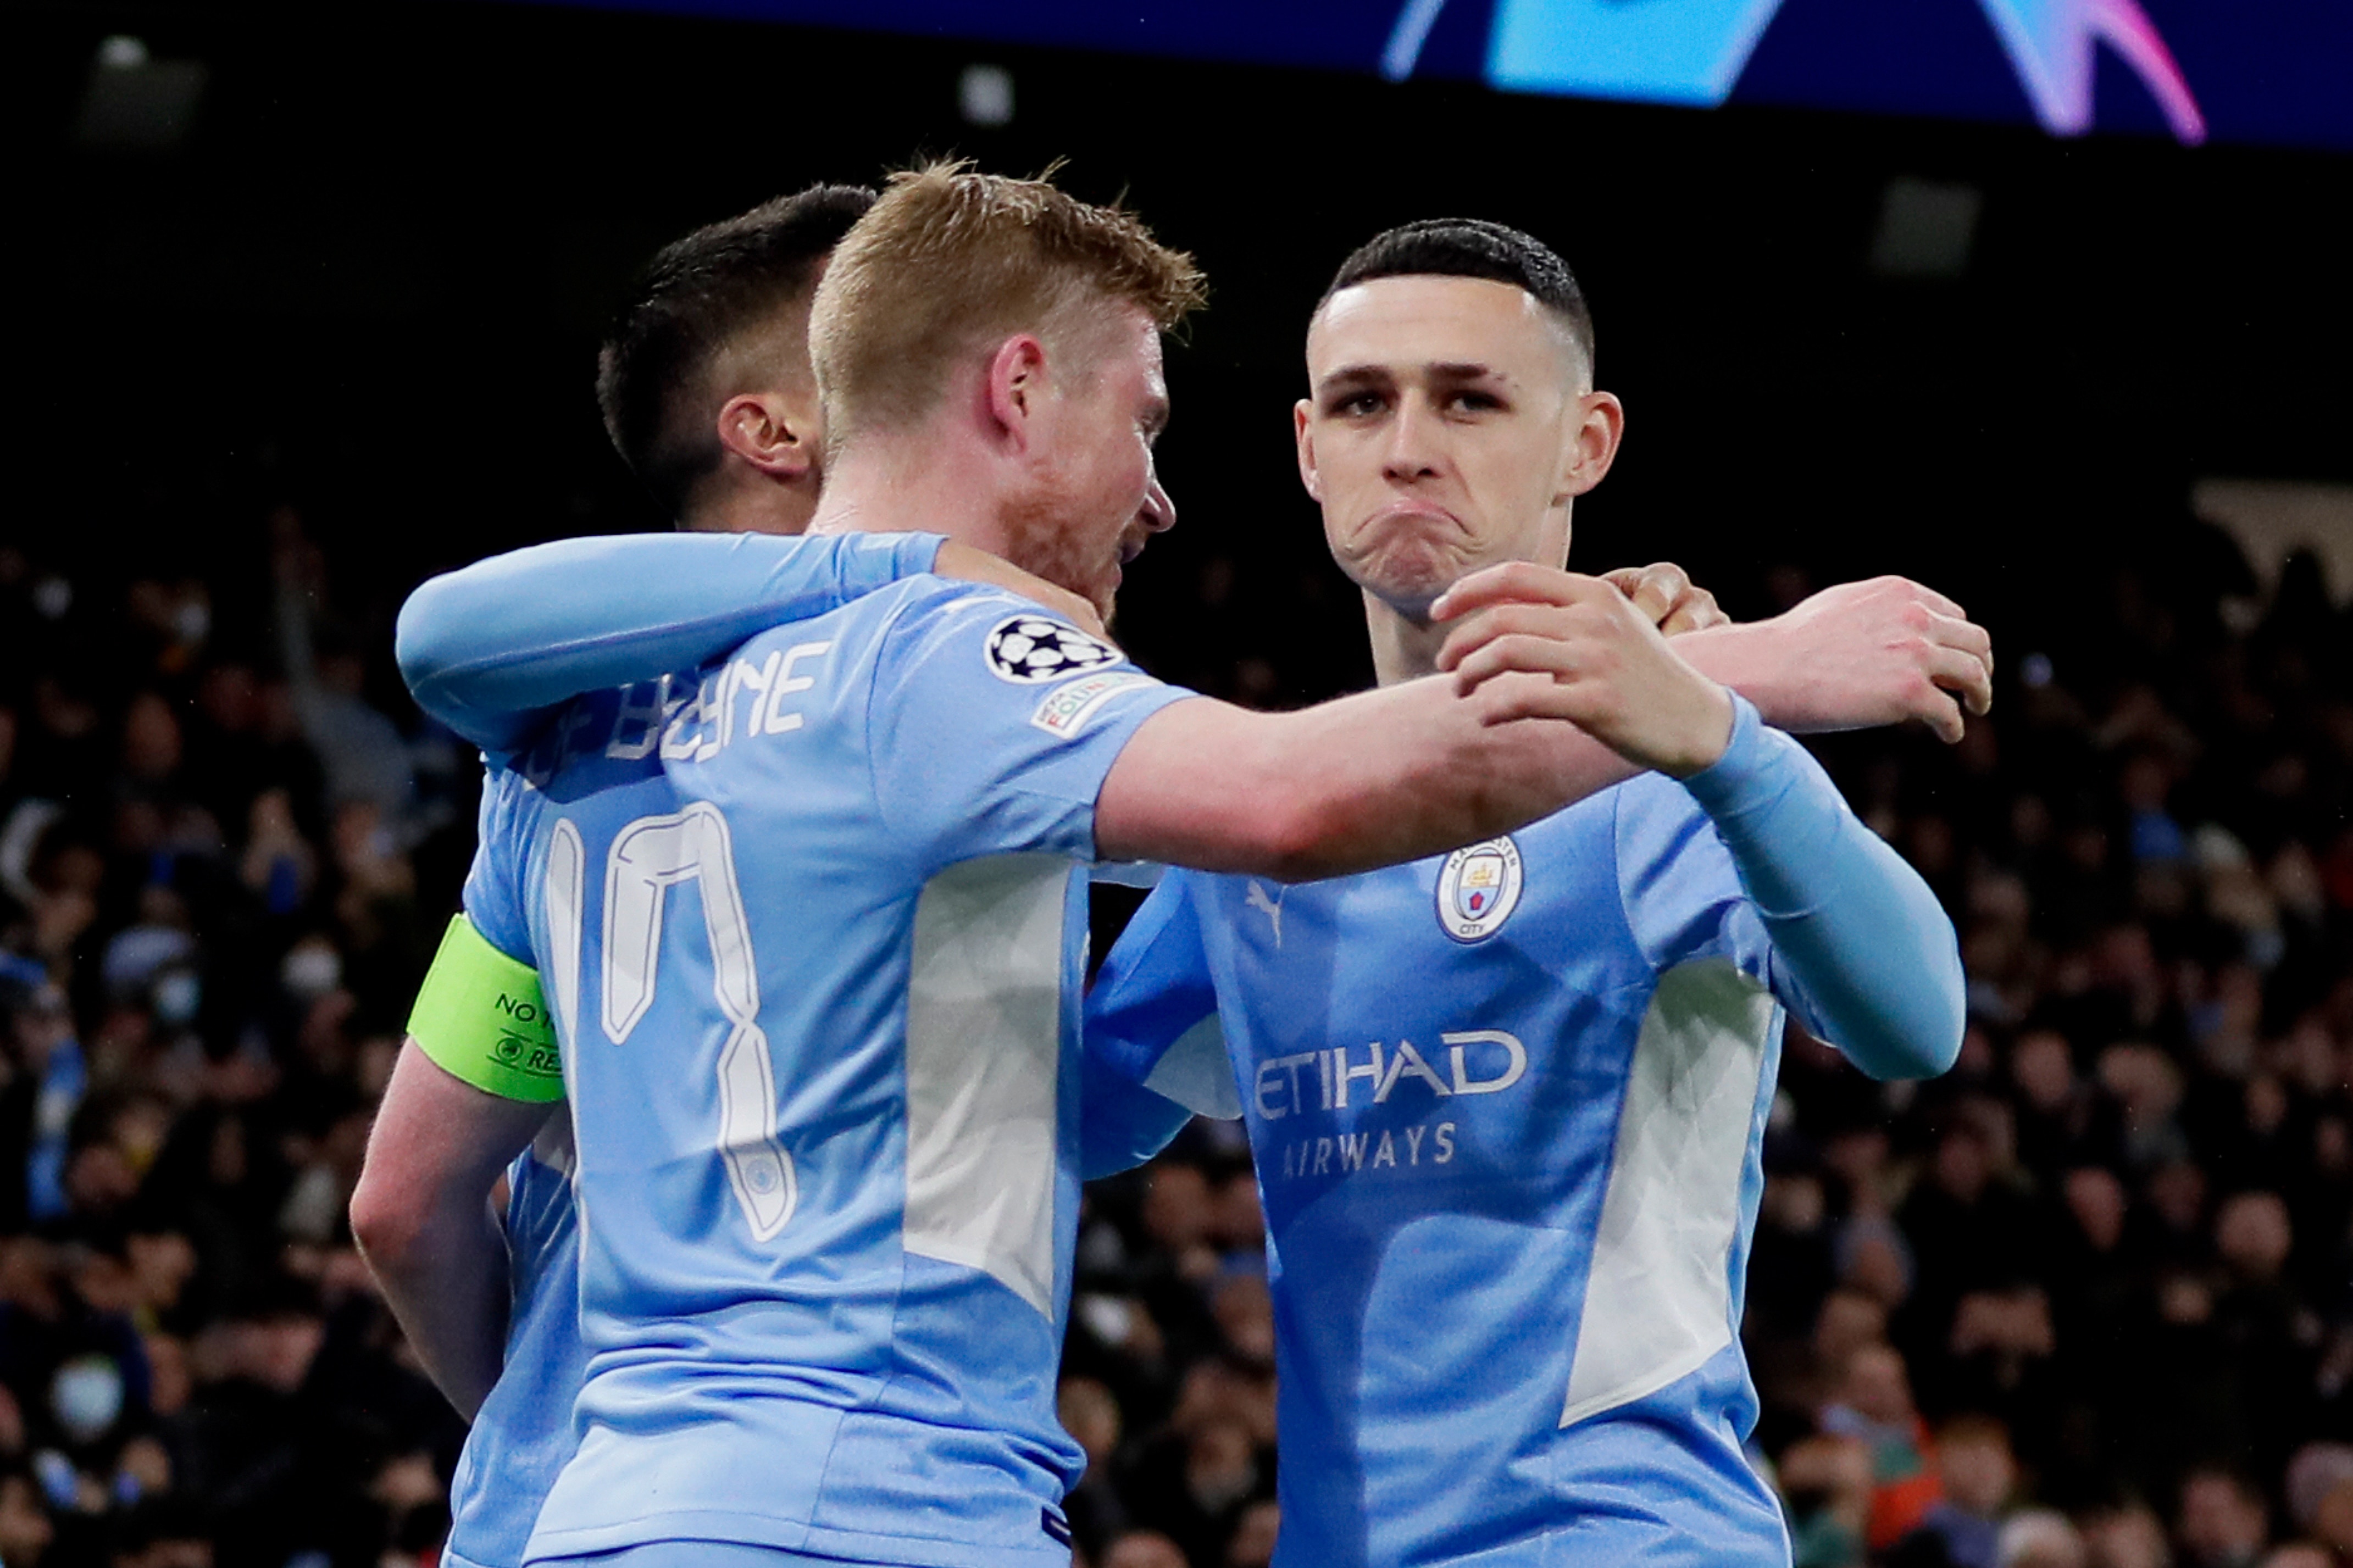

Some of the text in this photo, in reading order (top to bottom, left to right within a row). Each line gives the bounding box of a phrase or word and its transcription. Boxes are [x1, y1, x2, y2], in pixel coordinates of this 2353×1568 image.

[1459, 924, 1486, 935] CITY
[495, 993, 537, 1022] NO
[1255, 1030, 1528, 1121] ETIHAD
[1284, 1122, 1456, 1178] AIRWAYS
